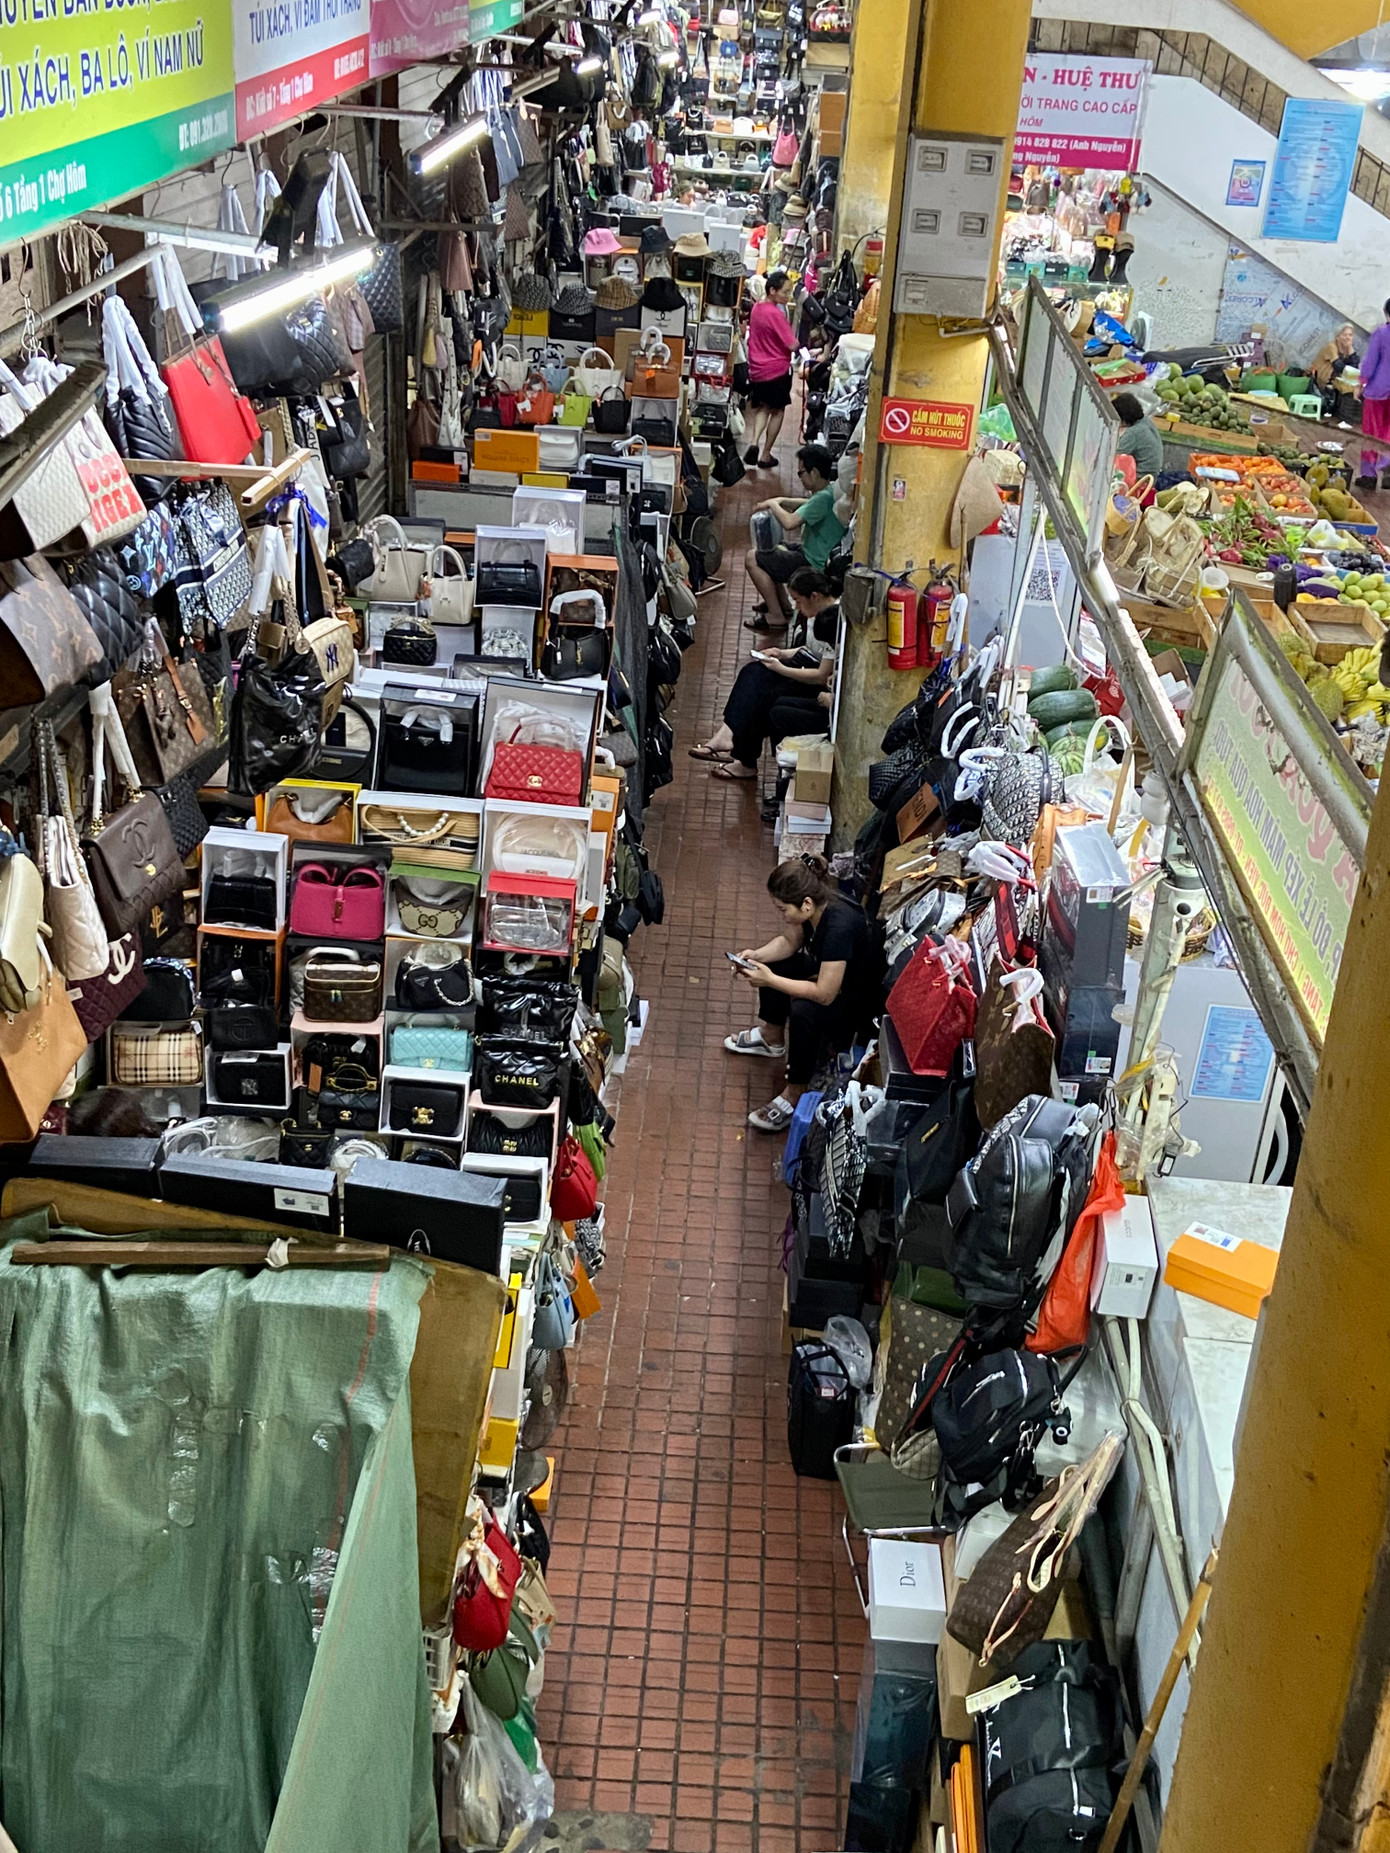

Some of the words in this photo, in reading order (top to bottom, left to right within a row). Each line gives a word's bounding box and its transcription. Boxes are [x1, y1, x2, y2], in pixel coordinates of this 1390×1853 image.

[18, 48, 77, 107] XÁCH,
[80, 51, 104, 95] BA
[108, 33, 133, 89] LÔ,
[135, 28, 151, 80] VÍ
[154, 33, 183, 76] NAM
[1052, 65, 1093, 92] HUỆ
[1099, 70, 1141, 90] THƯ
[1037, 98, 1078, 112] TRANG
[1083, 100, 1108, 114] CAO
[1112, 98, 1137, 116] CẤP
[1019, 115, 1043, 127] HÔM
[1070, 140, 1090, 151] (Anh
[47, 169, 65, 204] Chợ
[66, 161, 87, 194] Hôm
[912, 406, 929, 424] CẤM
[929, 408, 943, 425] HÚT
[910, 426, 923, 436] NO
[924, 427, 964, 440] SMOKING
[495, 1074, 540, 1087] CHANEL
[900, 1561, 916, 1587] Dior
